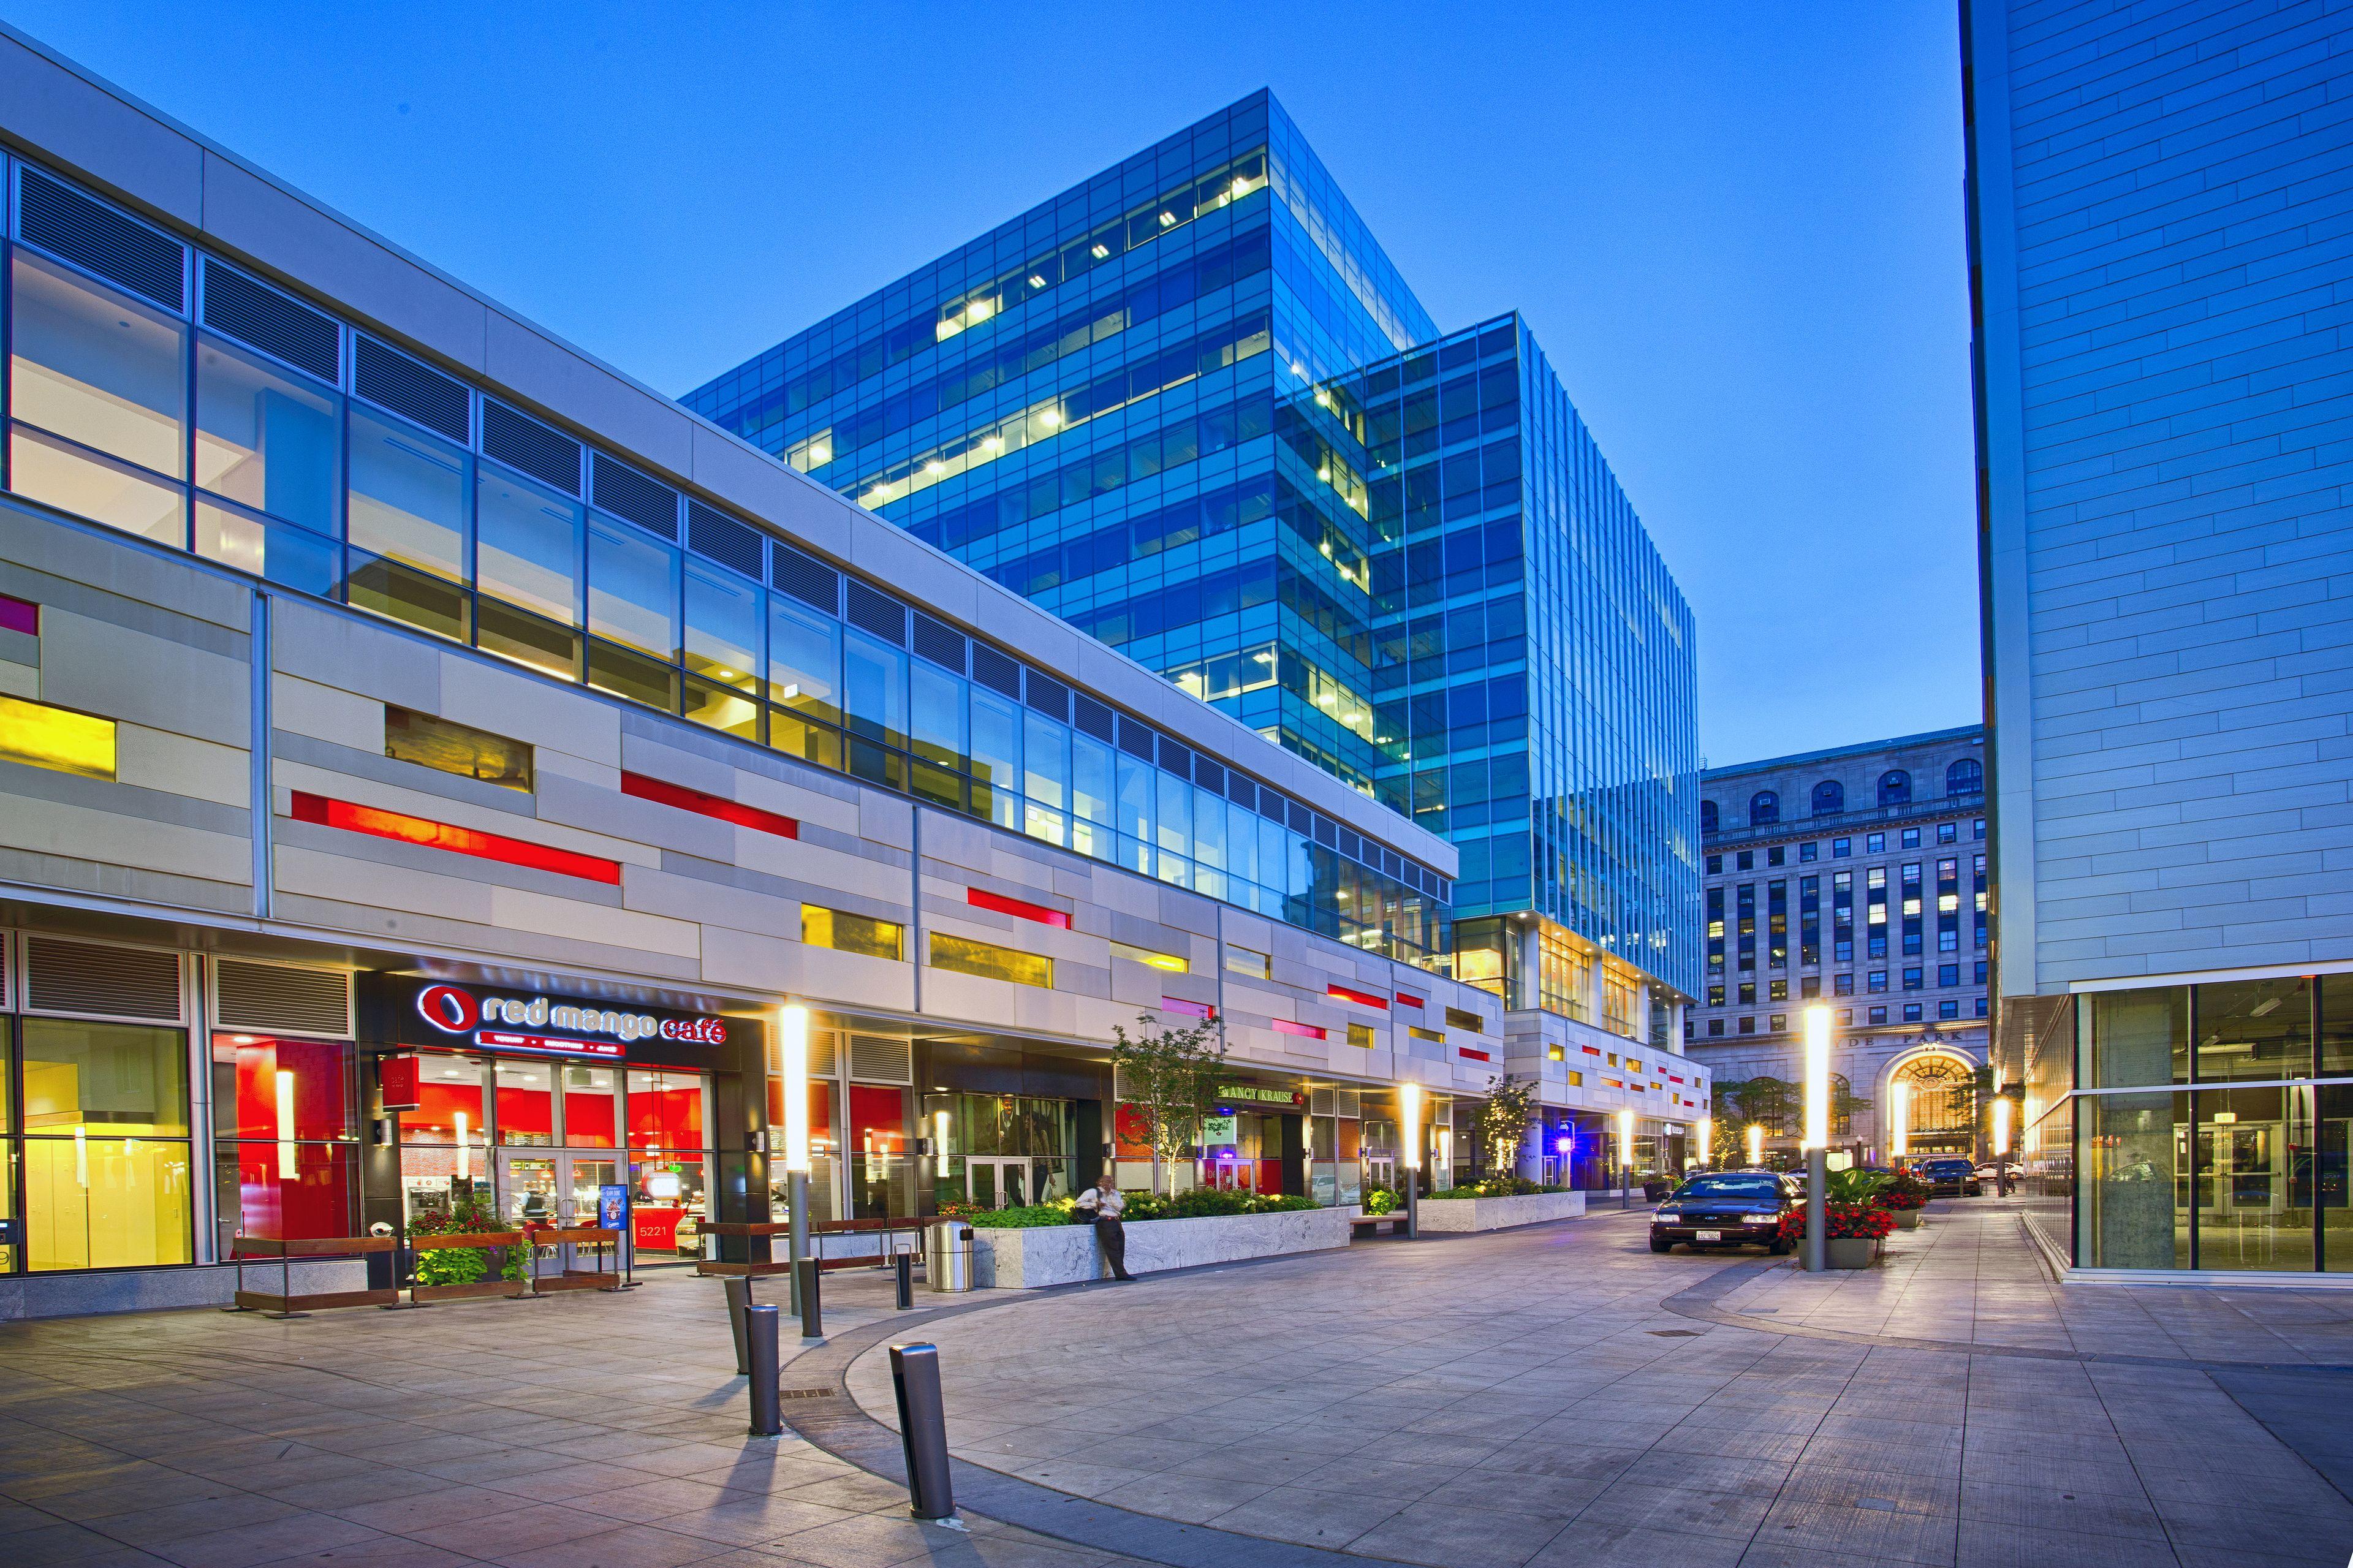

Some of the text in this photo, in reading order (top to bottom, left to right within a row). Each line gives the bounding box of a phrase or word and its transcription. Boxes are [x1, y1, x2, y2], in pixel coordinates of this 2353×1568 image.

[483, 998, 727, 1043] red mango café
[1903, 1032, 1962, 1043] PARK
[1261, 1089, 1294, 1103] KRAUSE
[640, 1227, 666, 1237] 5221
